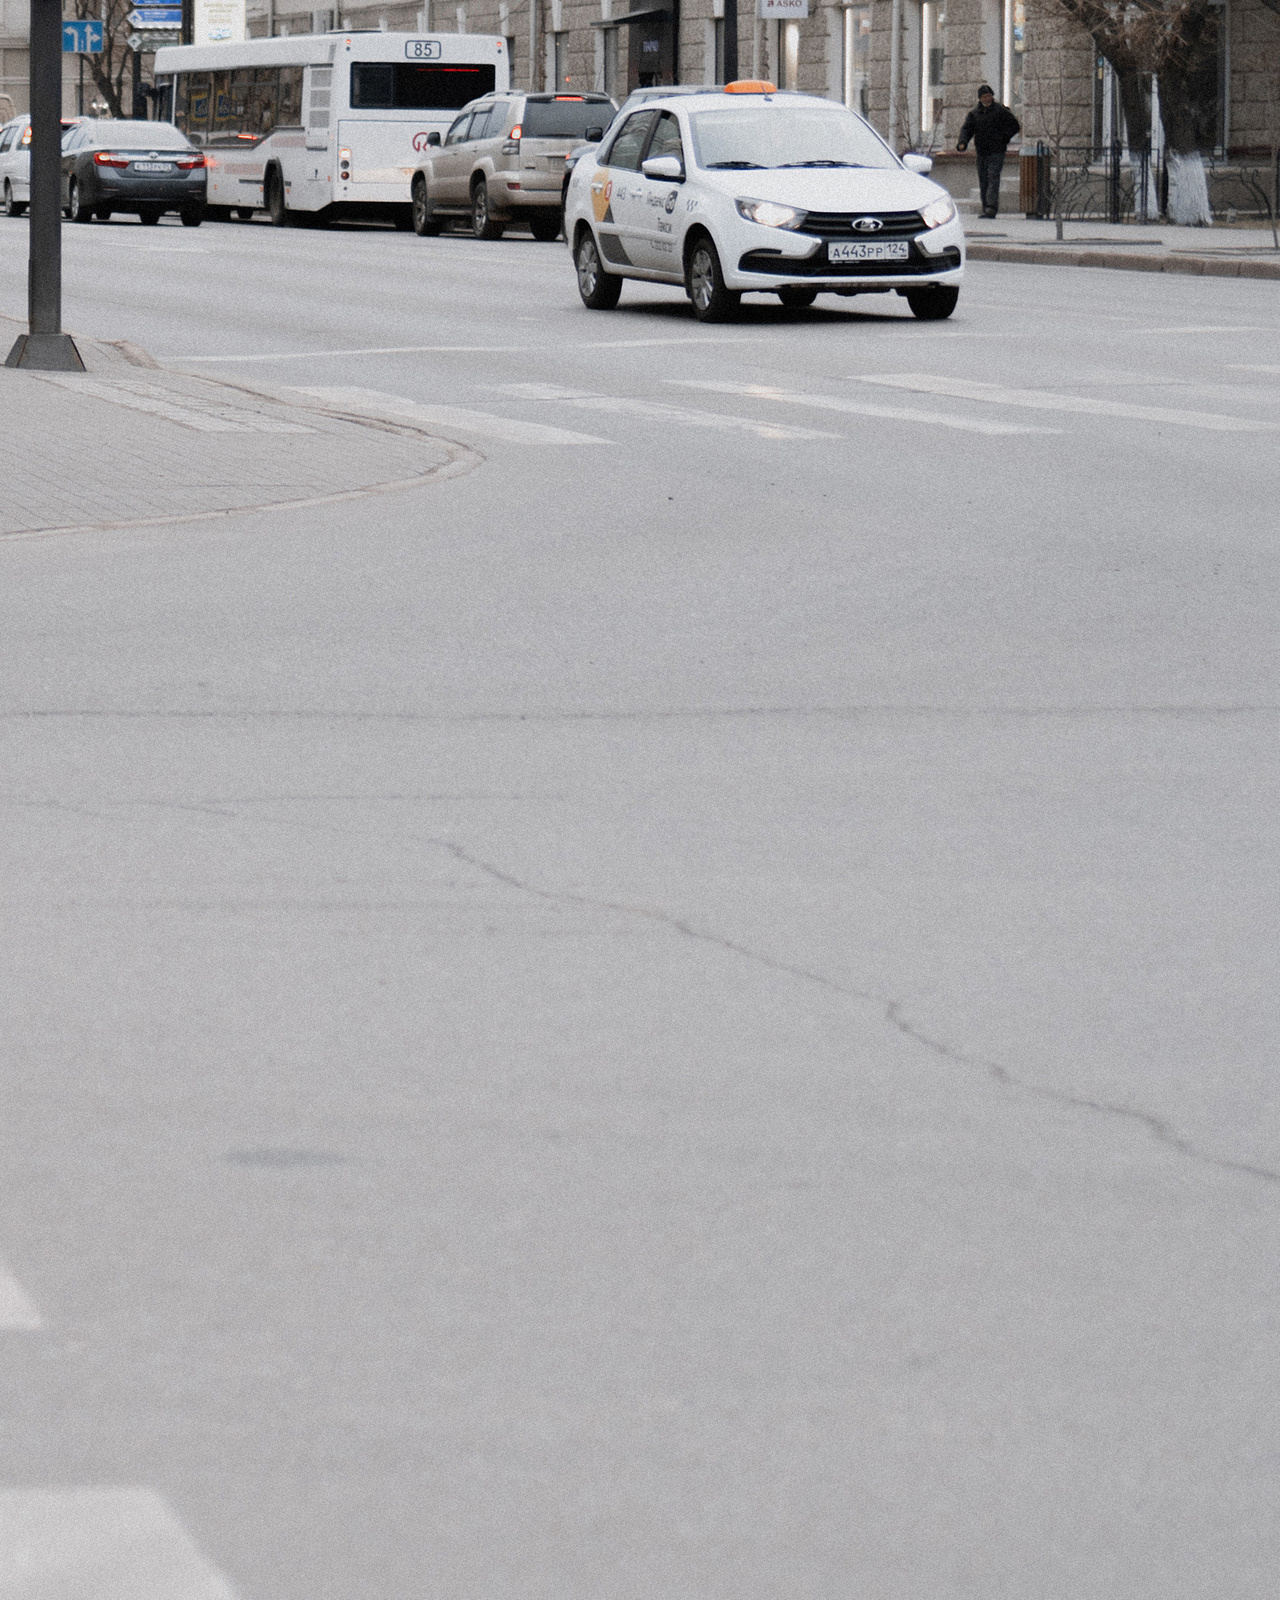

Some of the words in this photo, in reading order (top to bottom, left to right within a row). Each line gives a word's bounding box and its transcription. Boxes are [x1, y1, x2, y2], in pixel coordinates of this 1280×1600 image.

[776, 0, 803, 8] ASKO
[414, 43, 433, 57] 85
[832, 245, 883, 258] А443РР
[887, 243, 906, 254] 124
